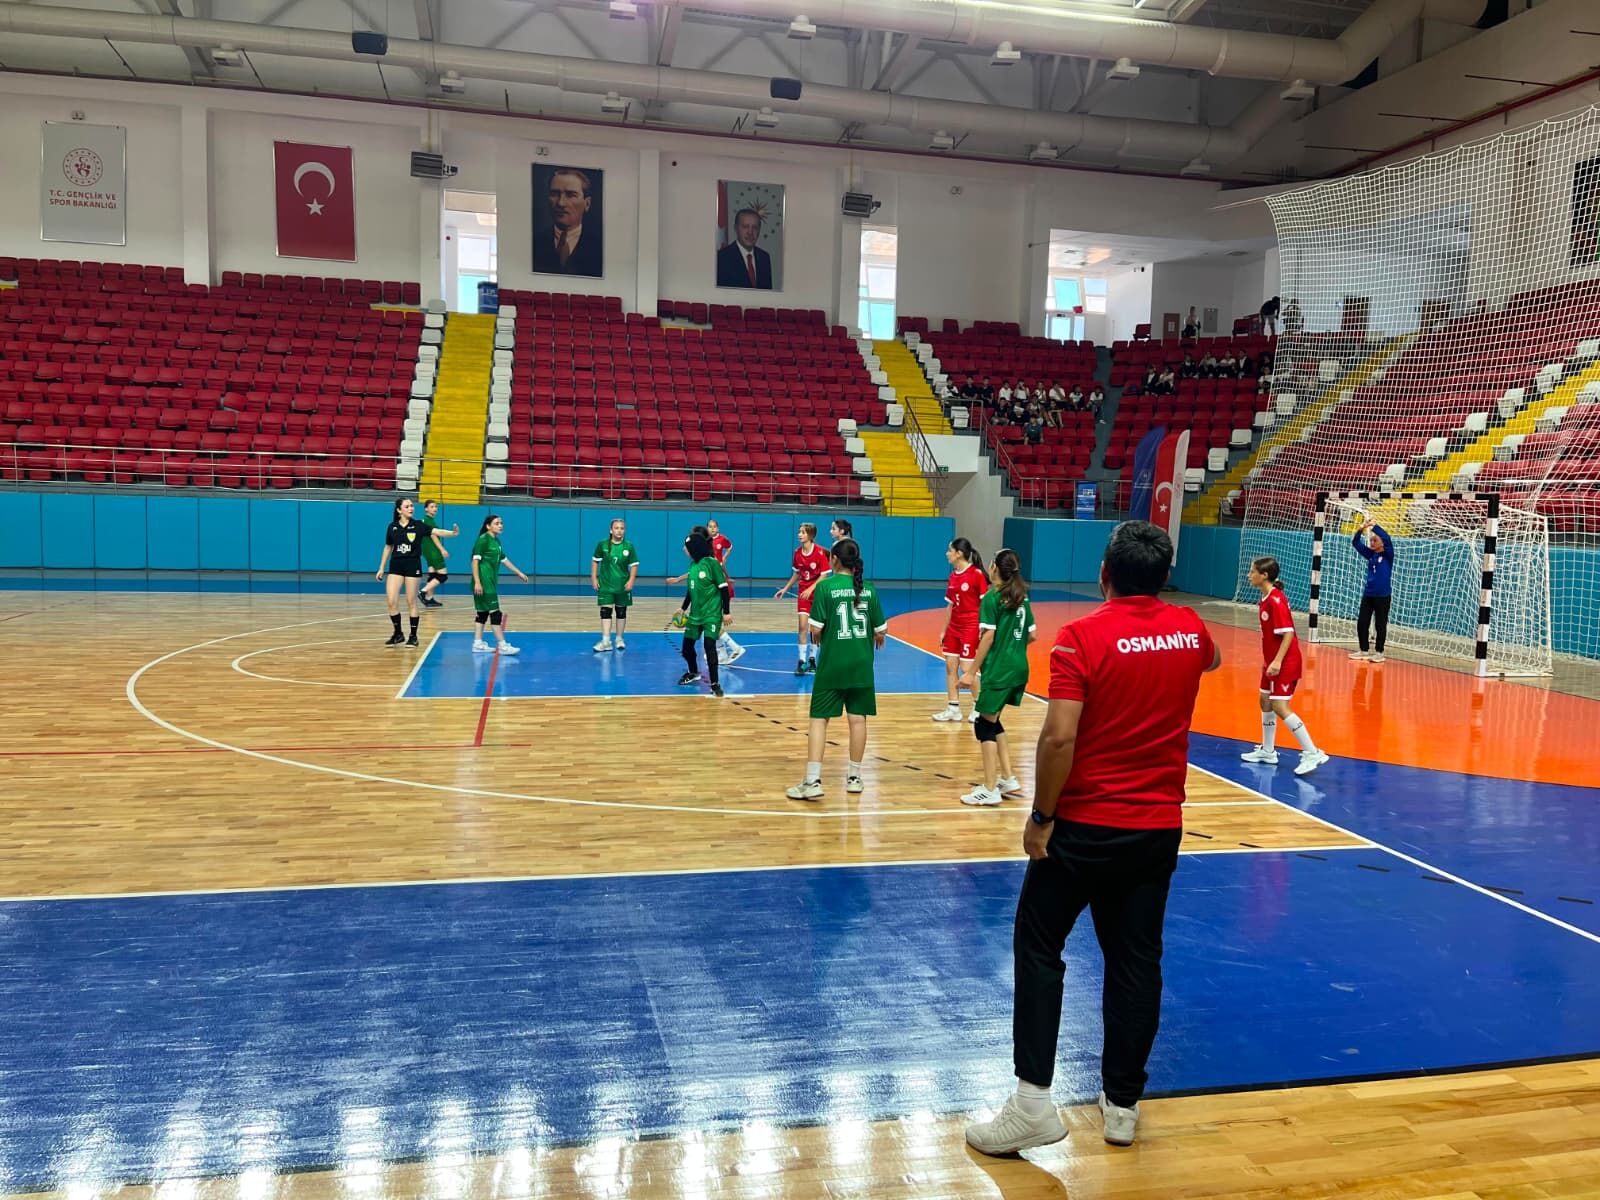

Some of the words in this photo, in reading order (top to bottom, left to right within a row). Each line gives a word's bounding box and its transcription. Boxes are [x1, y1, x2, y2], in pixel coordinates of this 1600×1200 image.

[49, 189, 65, 197] T.C.
[66, 191, 103, 200] GENÇLİK
[73, 200, 117, 209] BAKANLIĞI
[804, 570, 810, 580] 3
[836, 601, 869, 640] 15
[1013, 605, 1026, 641] 3
[1116, 630, 1200, 654] OSMANİYE
[962, 643, 970, 657] 5
